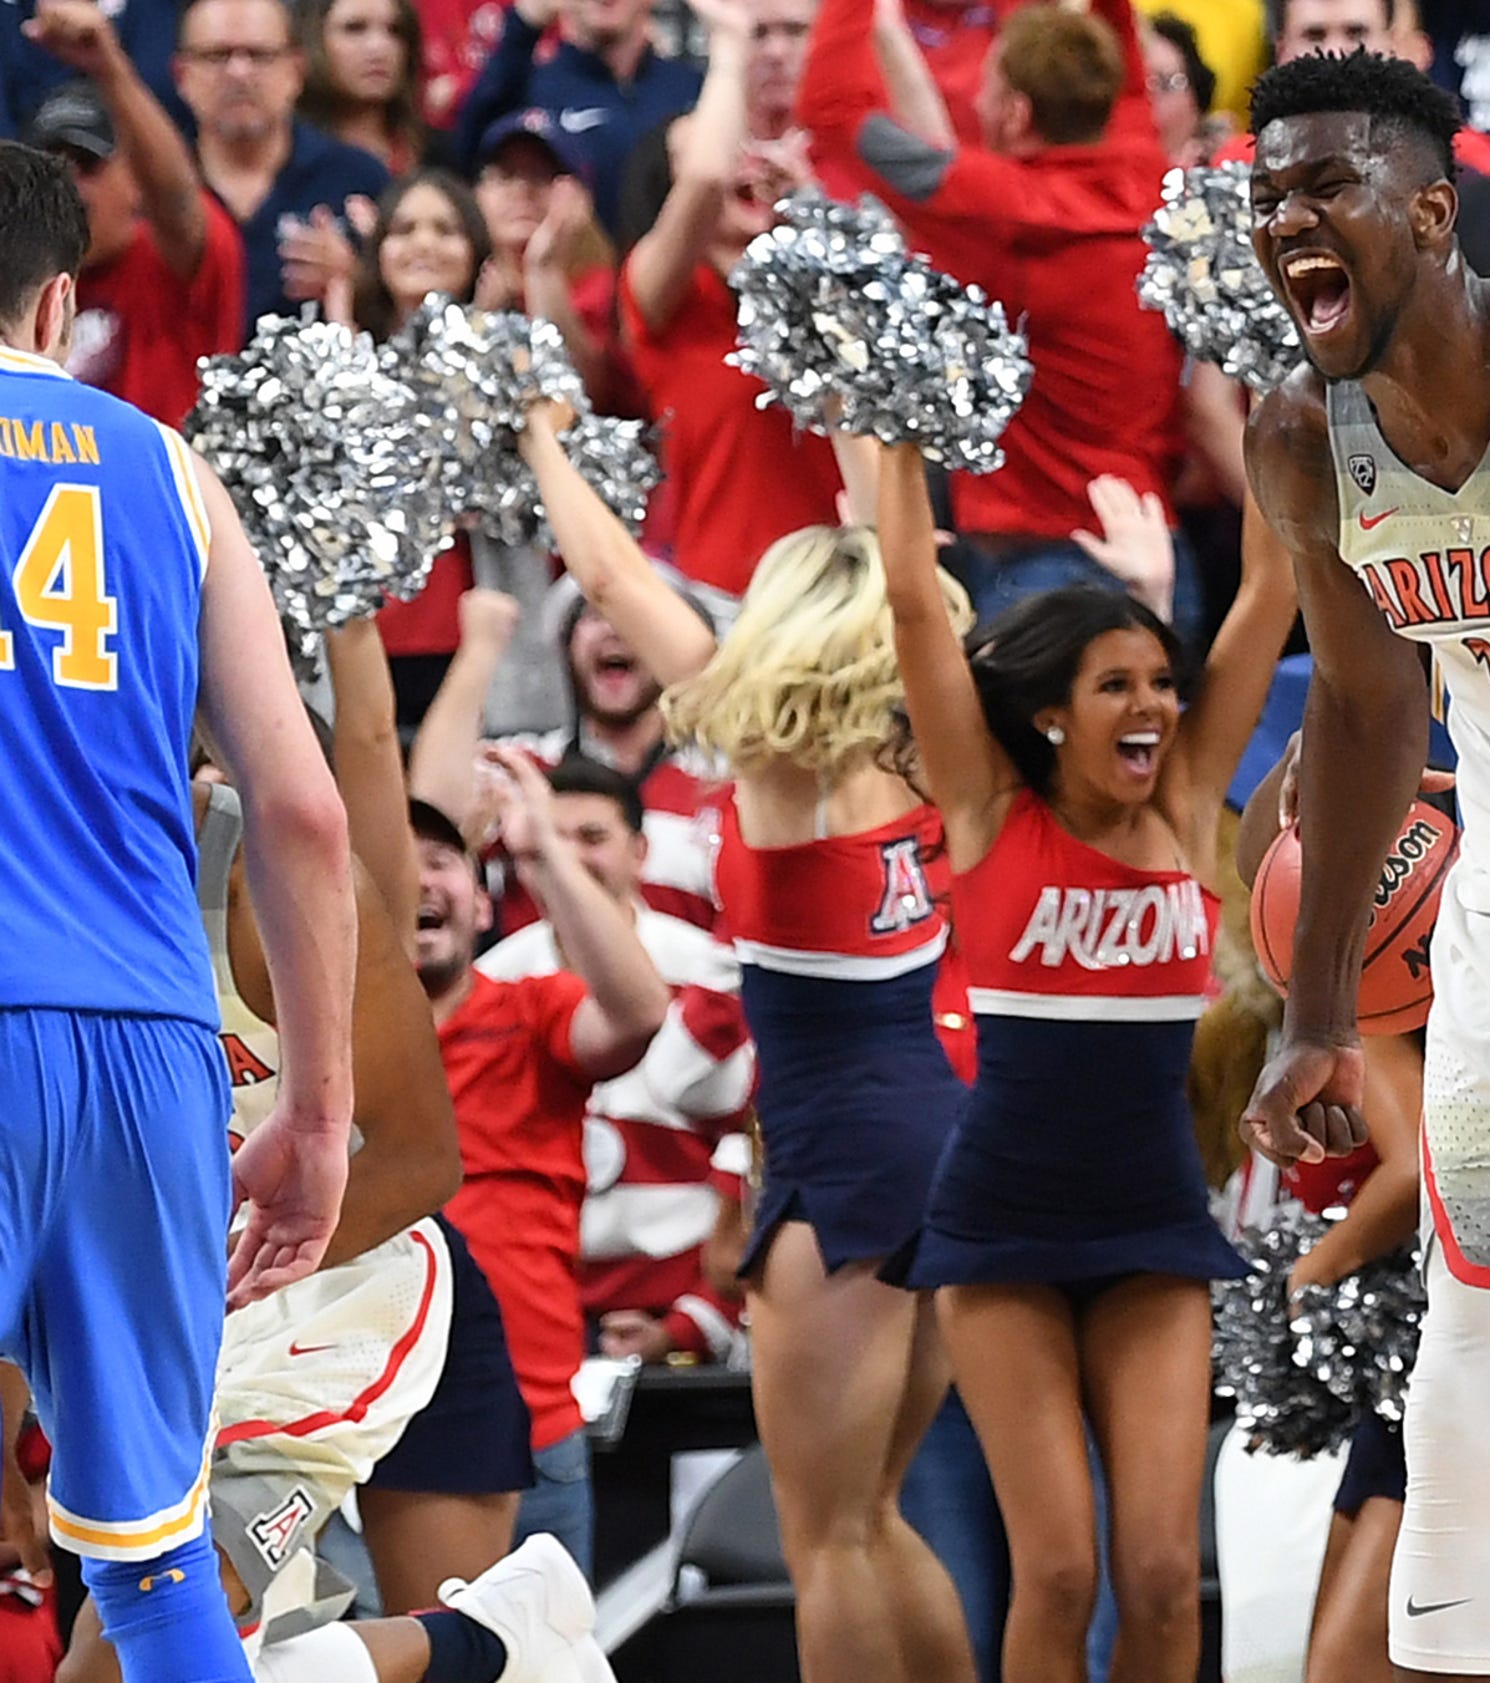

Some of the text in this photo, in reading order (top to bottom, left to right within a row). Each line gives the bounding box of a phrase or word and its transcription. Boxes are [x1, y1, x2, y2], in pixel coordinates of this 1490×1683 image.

[0, 482, 118, 691] 4
[872, 836, 935, 935] A
[1009, 879, 1208, 970] ARIZONA
[246, 1485, 317, 1572] A
